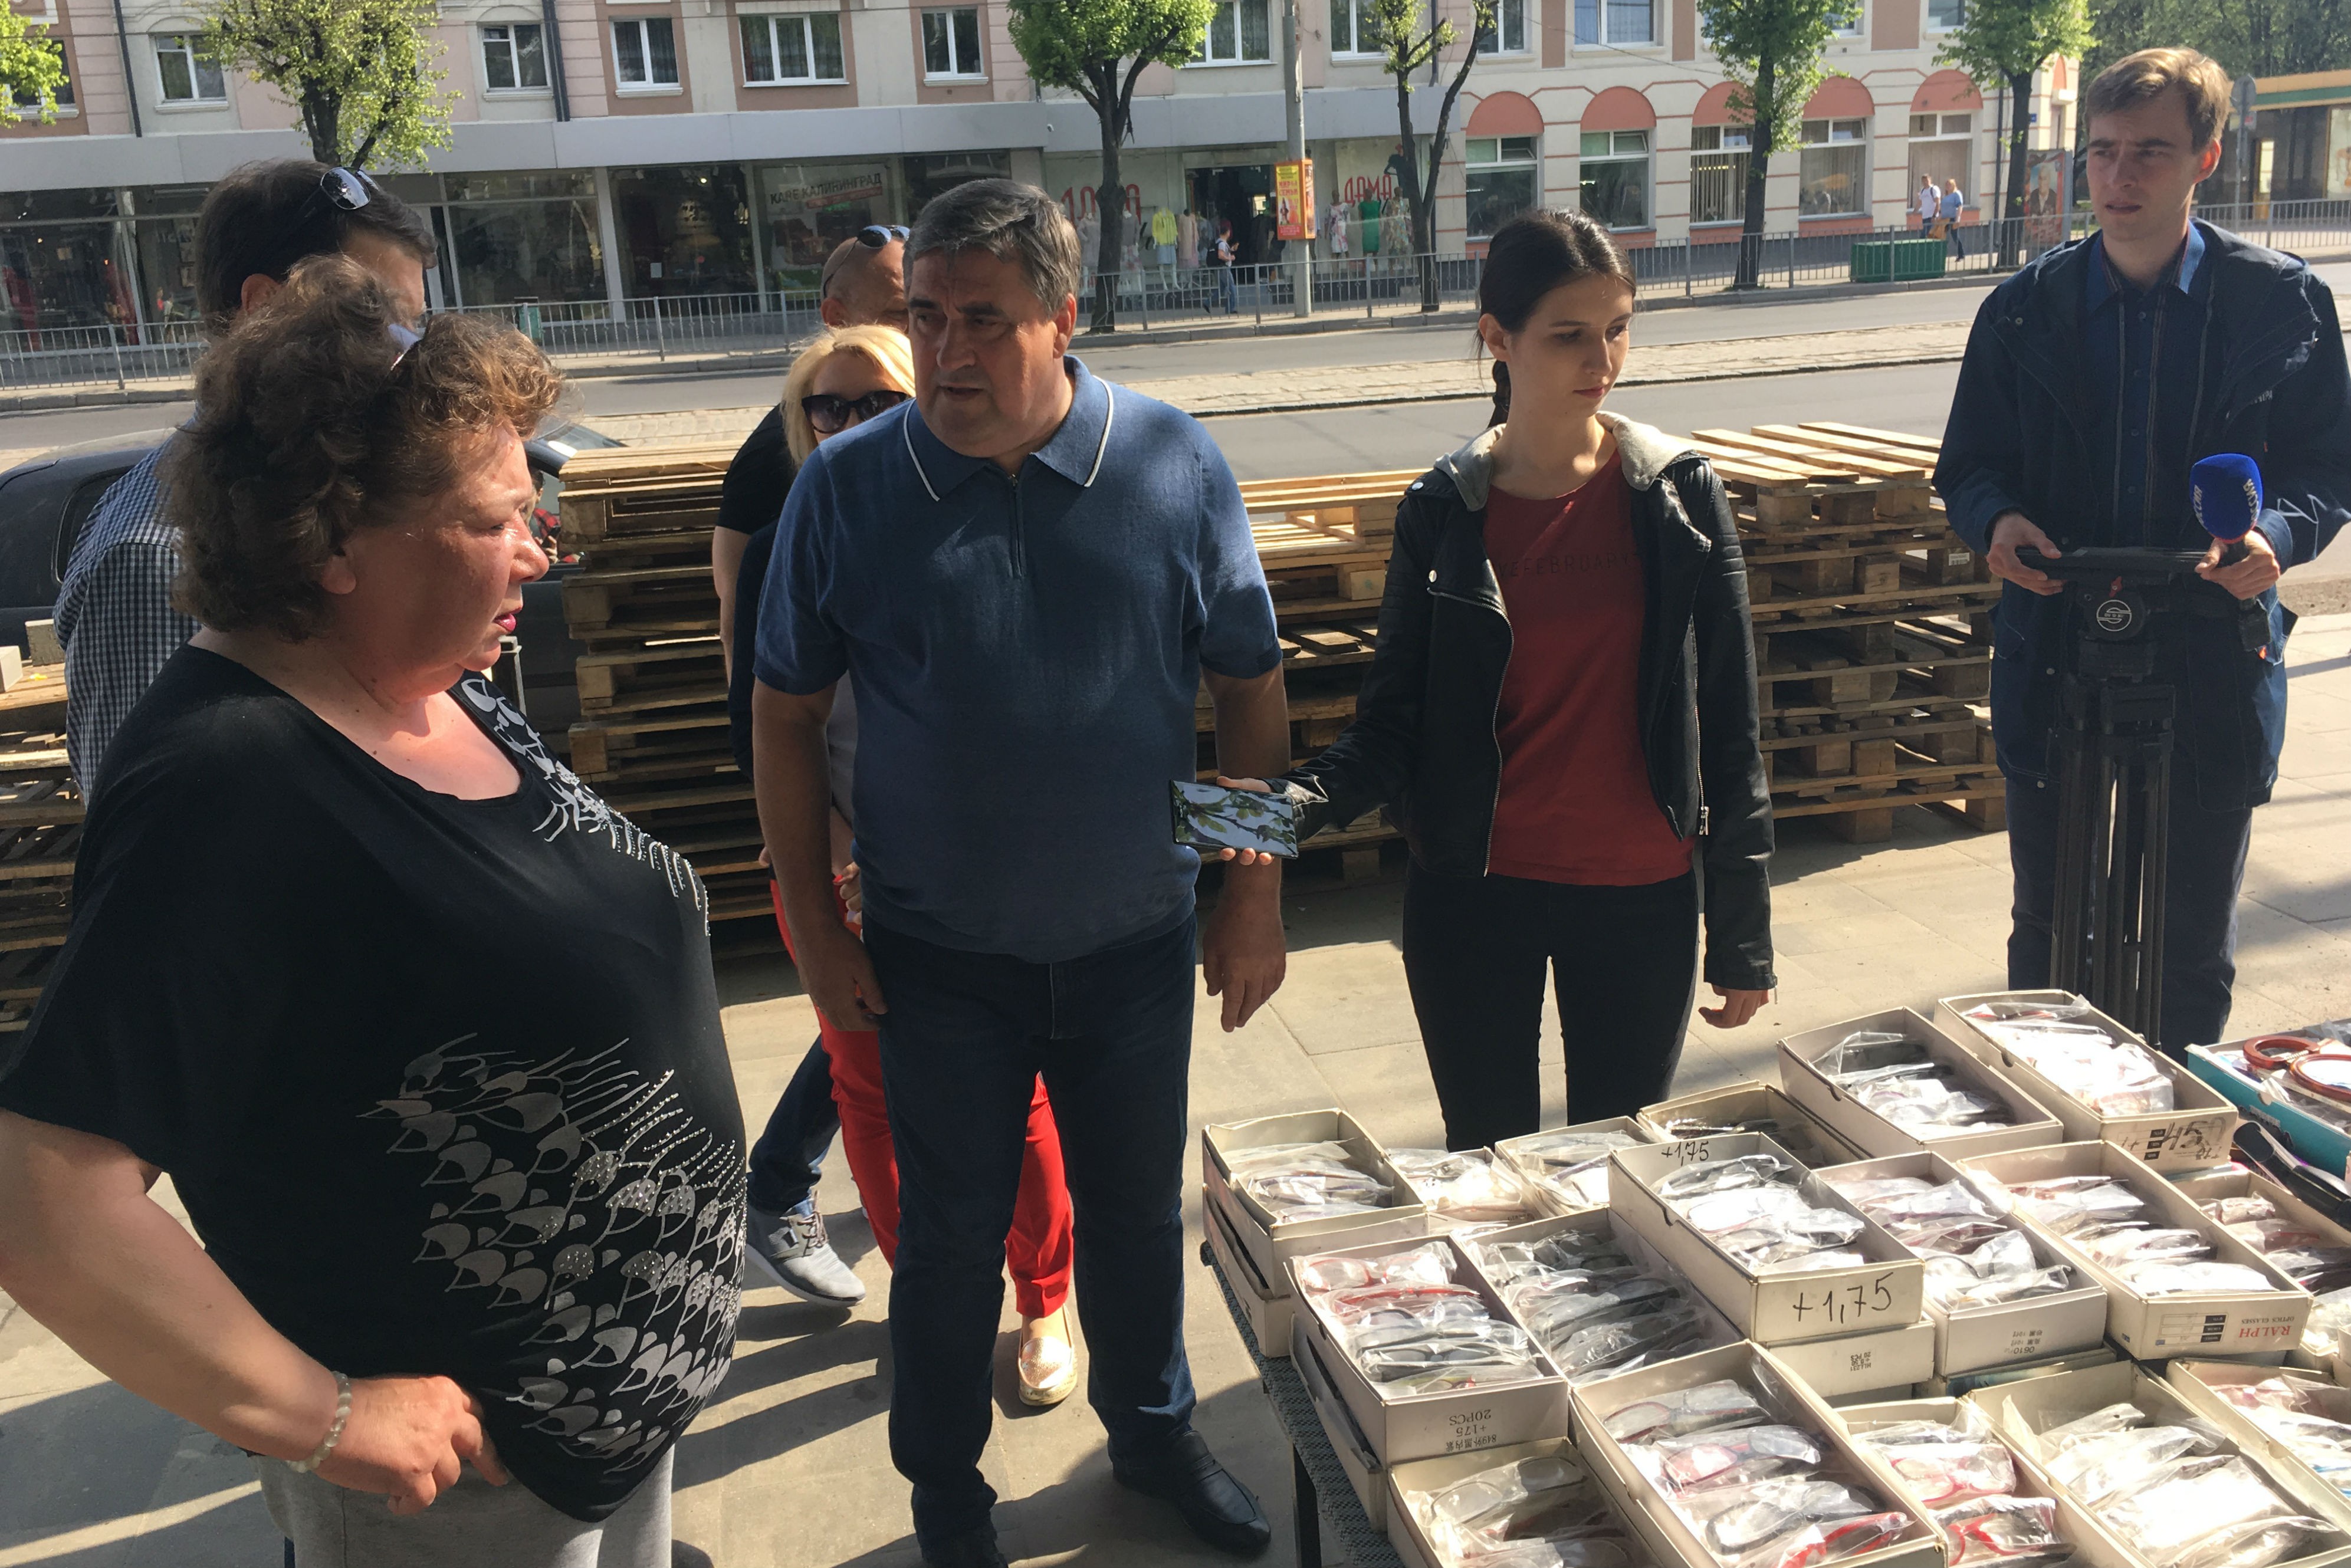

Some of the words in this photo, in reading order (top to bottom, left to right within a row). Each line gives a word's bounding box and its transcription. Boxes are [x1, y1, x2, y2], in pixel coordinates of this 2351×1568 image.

[1344, 173, 1393, 208] ДАМА
[2194, 484, 2208, 530] ОССИЯ
[2242, 478, 2260, 525] ОССИЯ
[1661, 1140, 1709, 1167] +1,75
[1792, 1271, 1894, 1324] +1,75
[2238, 1325, 2291, 1339] RALPH
[1449, 1409, 1492, 1426] 20PCS
[1456, 1424, 1487, 1437] +175
